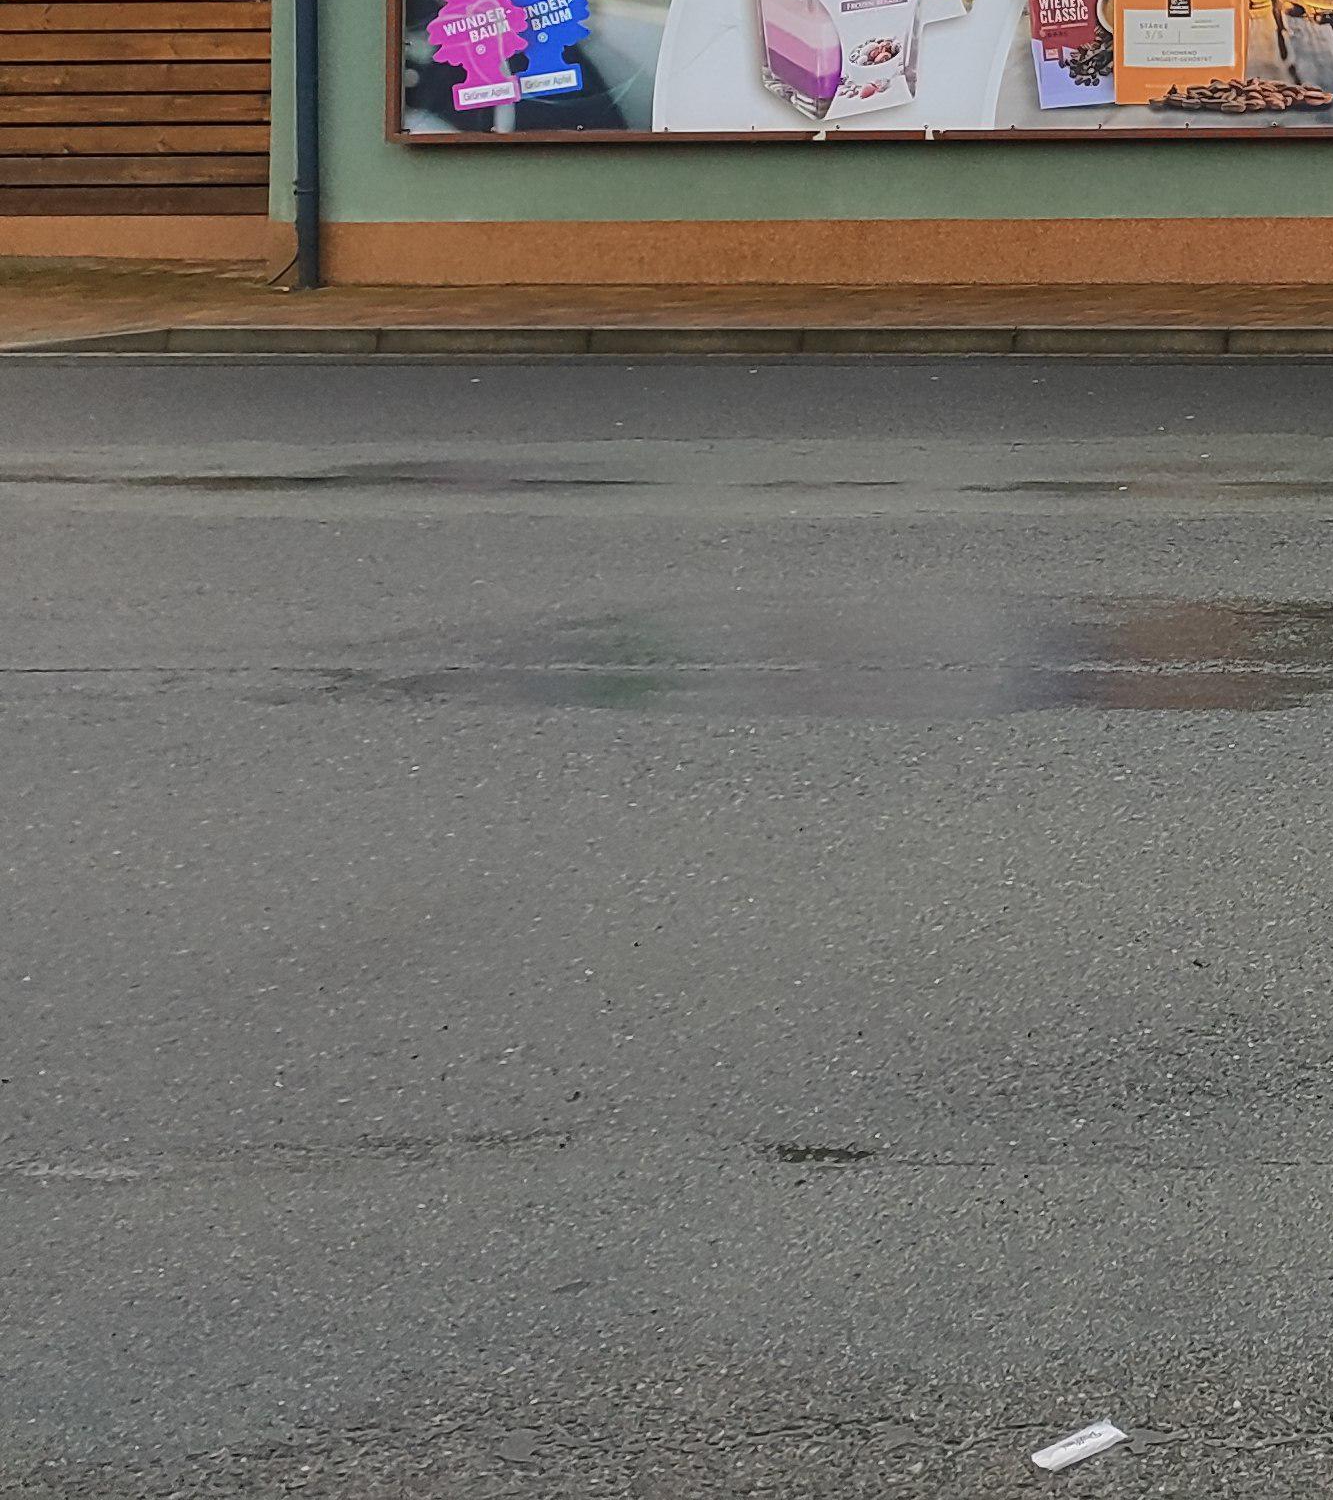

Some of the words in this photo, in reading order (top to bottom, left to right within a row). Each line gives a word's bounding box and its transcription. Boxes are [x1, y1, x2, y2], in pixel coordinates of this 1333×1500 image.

[442, 7, 513, 37] WUNDER-
[530, 8, 574, 32] BAUM
[1039, 5, 1089, 24] CLASSIC
[468, 19, 511, 44] BAUM
